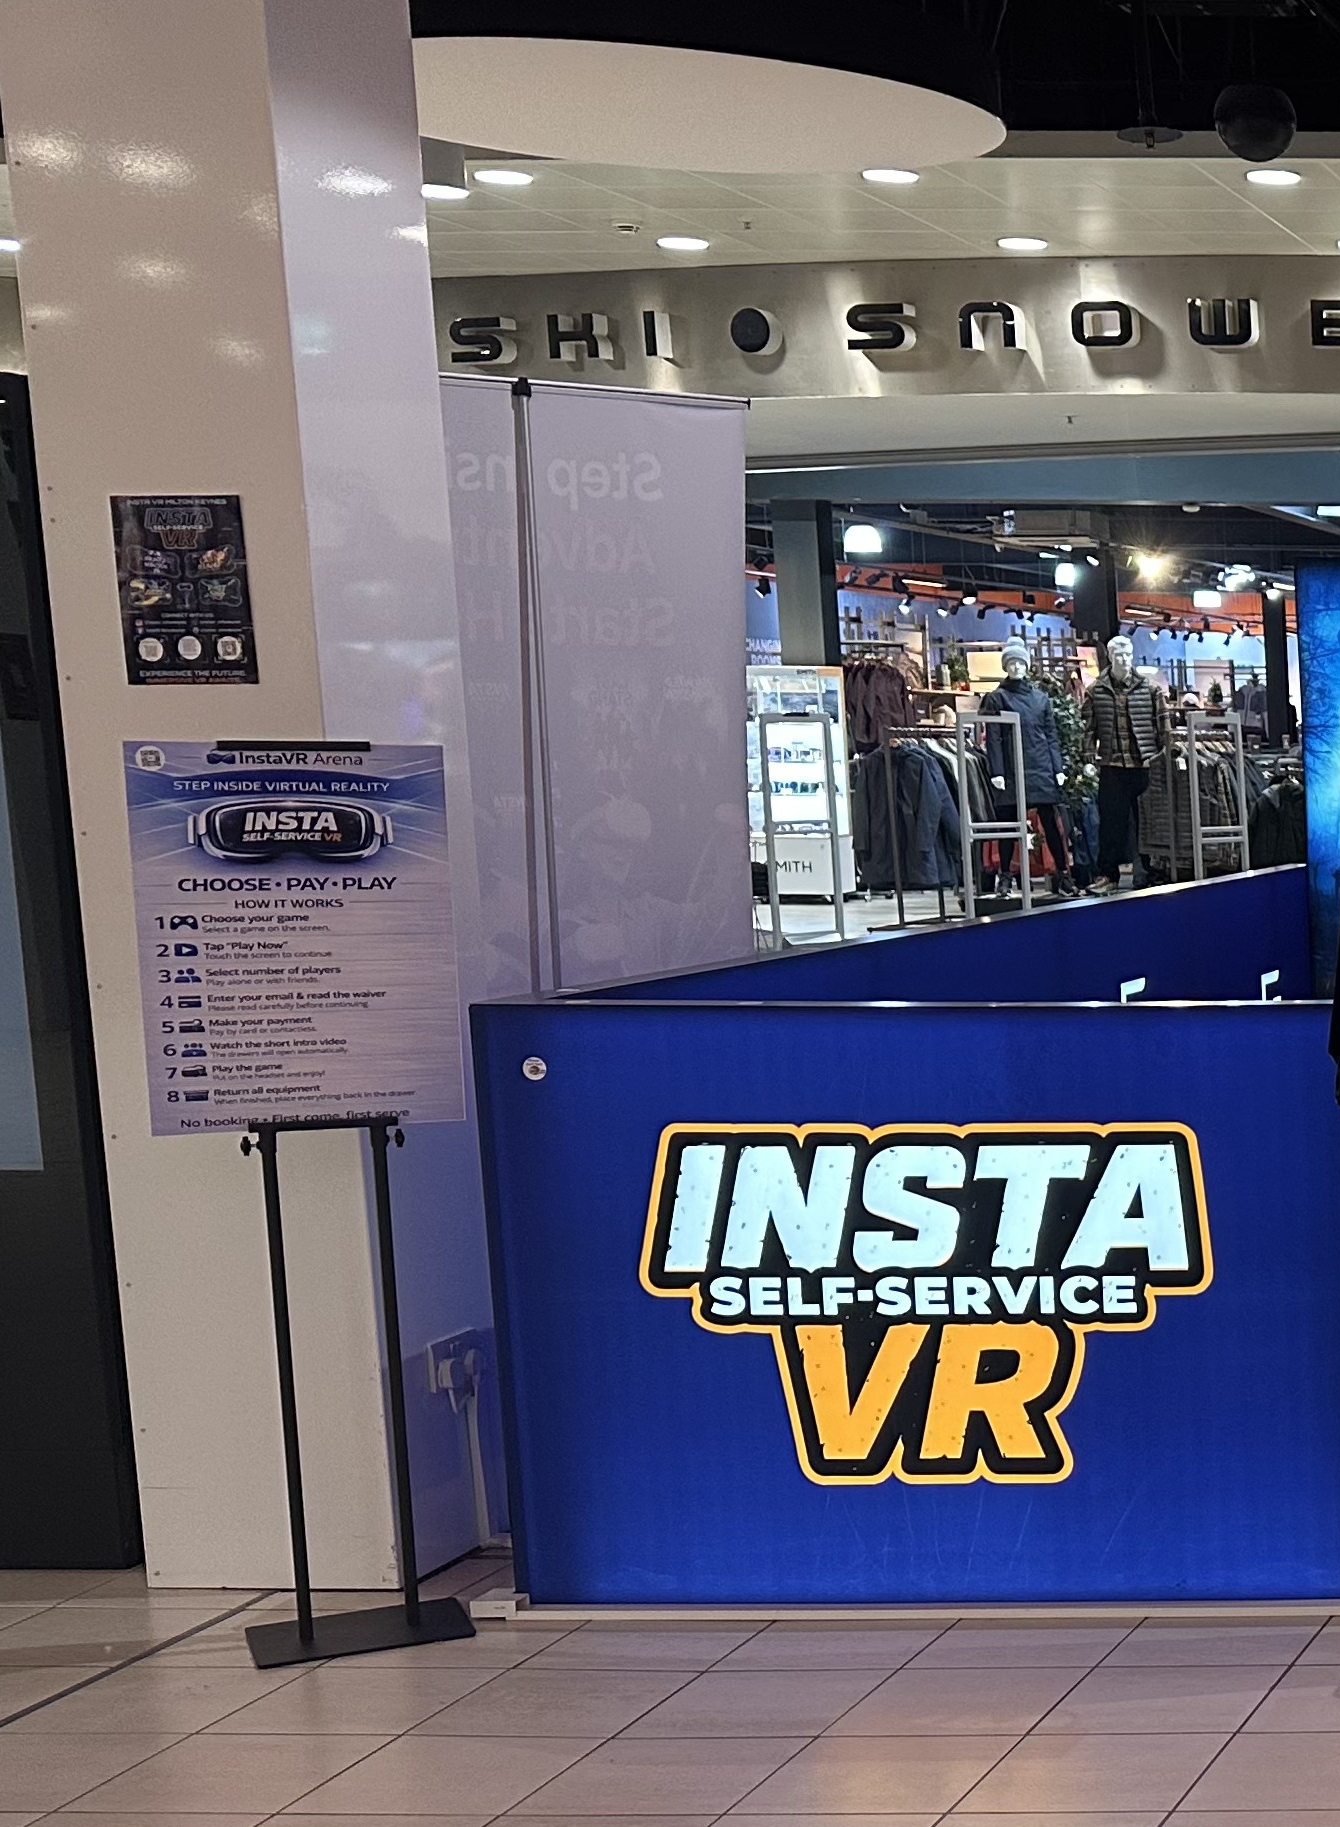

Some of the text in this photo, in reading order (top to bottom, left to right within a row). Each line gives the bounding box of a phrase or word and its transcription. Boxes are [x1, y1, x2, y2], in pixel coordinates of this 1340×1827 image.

[449, 309, 660, 365] SKI
[239, 751, 363, 766] InstaVR Arena
[173, 780, 391, 793] STEP INSIDE VIRTUAL REALITY
[244, 811, 338, 832] INSTA
[241, 832, 342, 843] SELF-SERVICE VR
[177, 876, 398, 892] CHOOSE PAY PLAY
[234, 898, 344, 909] HOW IT WORKS
[154, 916, 165, 930] 1
[201, 914, 310, 927] Choose your game
[156, 943, 170, 958] 2
[203, 942, 225, 952] Tap
[158, 969, 172, 983] 3
[205, 966, 342, 977] Select number of players
[159, 995, 174, 1009] 4
[207, 989, 387, 1004] Enter your email & read the waiver
[162, 1020, 175, 1034] 5
[208, 1016, 313, 1028] Make your payment
[163, 1043, 177, 1057] 6
[210, 1038, 347, 1050] Watch the short intro video
[164, 1067, 178, 1080] 7
[212, 1063, 283, 1074] Play the game
[166, 1090, 180, 1103] 8
[213, 1088, 250, 1097] Return
[265, 1085, 321, 1095] equipment
[181, 1119, 201, 1128] No
[663, 1142, 1191, 1274] INSTA
[709, 1275, 1138, 1317] SELF-SERVICE
[796, 1322, 1062, 1462] VR
